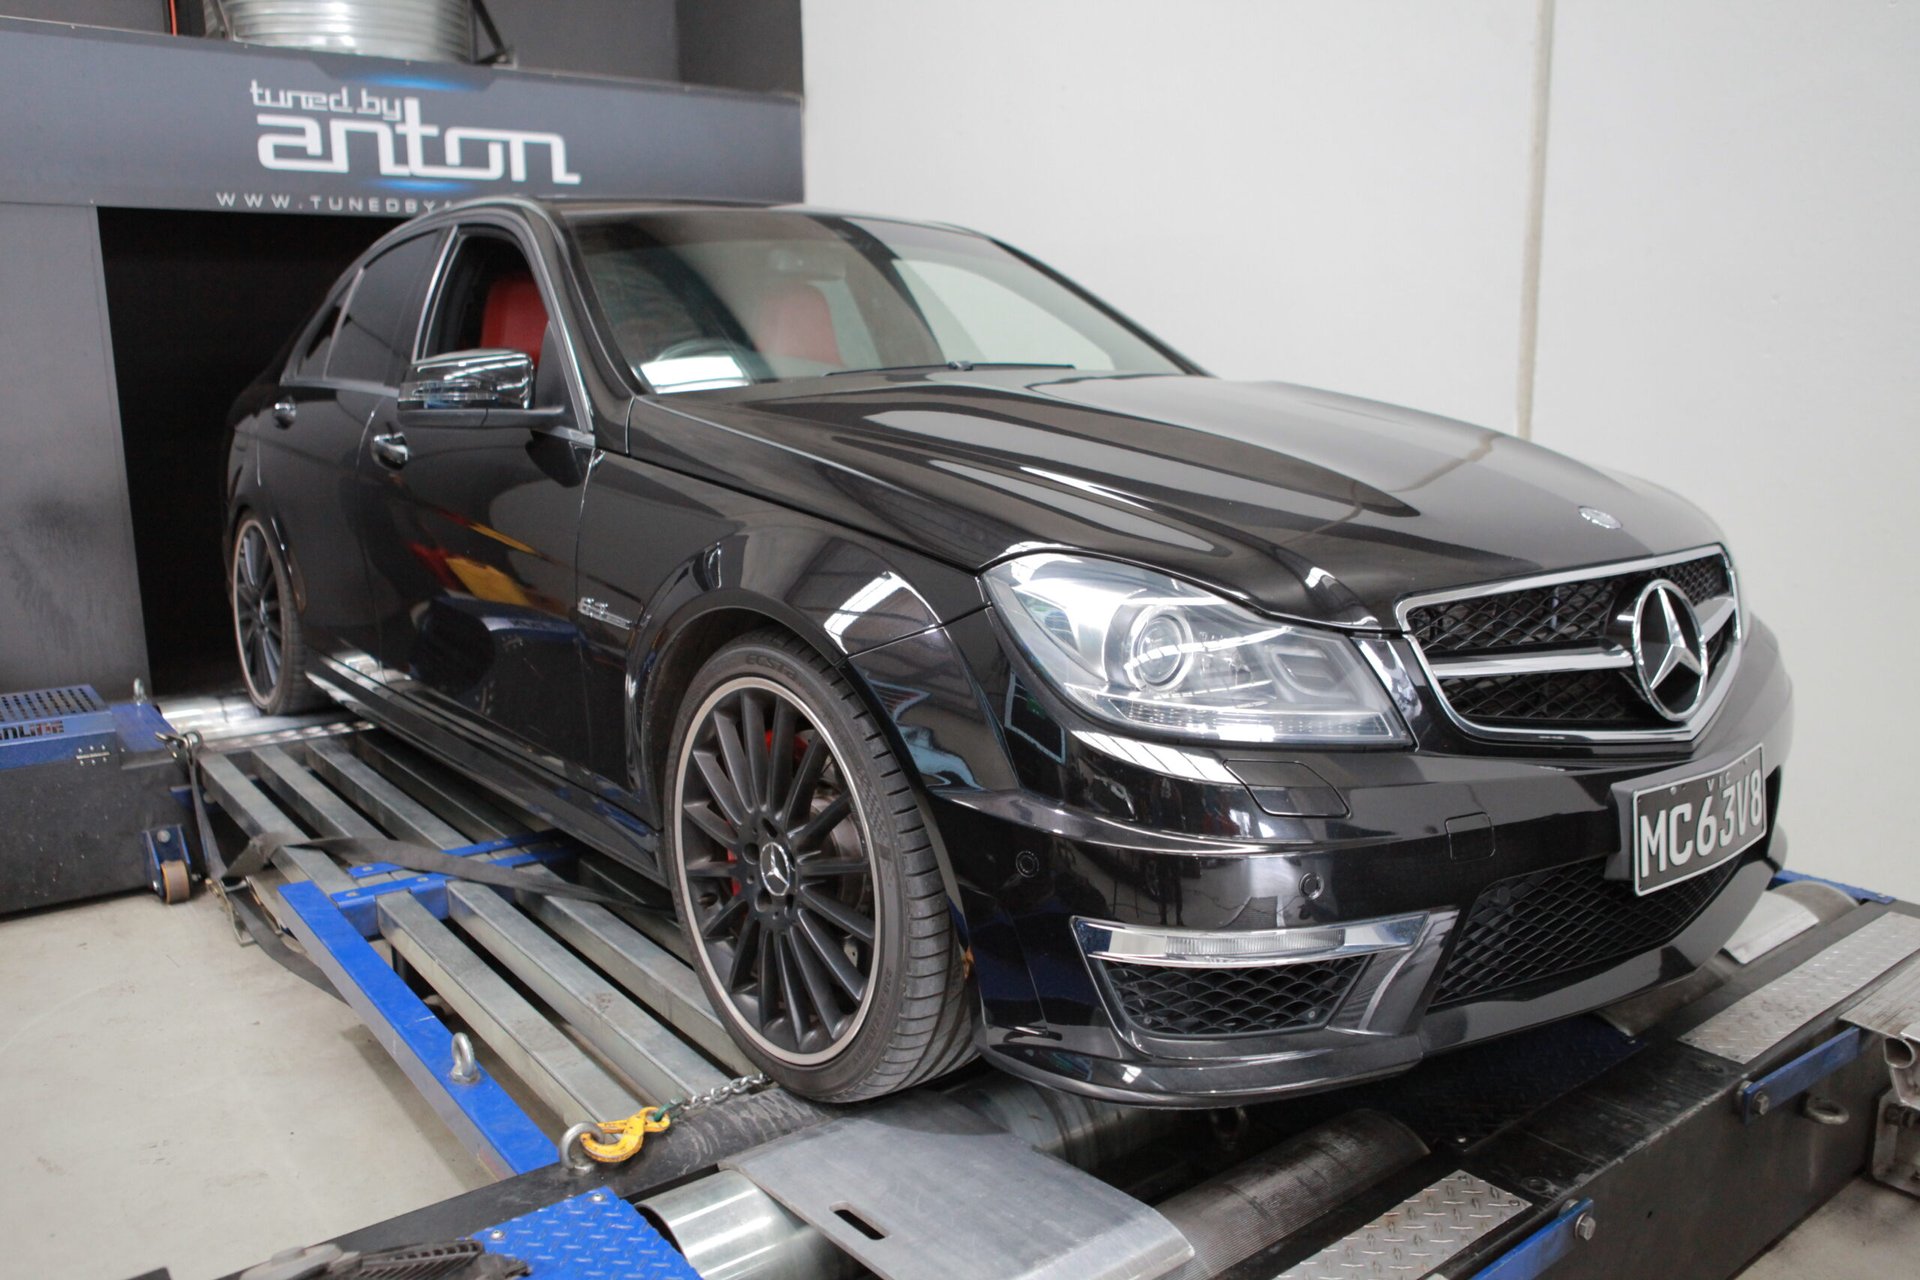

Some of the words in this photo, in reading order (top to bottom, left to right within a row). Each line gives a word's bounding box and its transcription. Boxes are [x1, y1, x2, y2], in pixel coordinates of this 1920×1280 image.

[250, 79, 353, 113] tuned
[356, 87, 401, 121] by
[257, 97, 581, 185] anton
[1640, 769, 1763, 878] MC63V8
